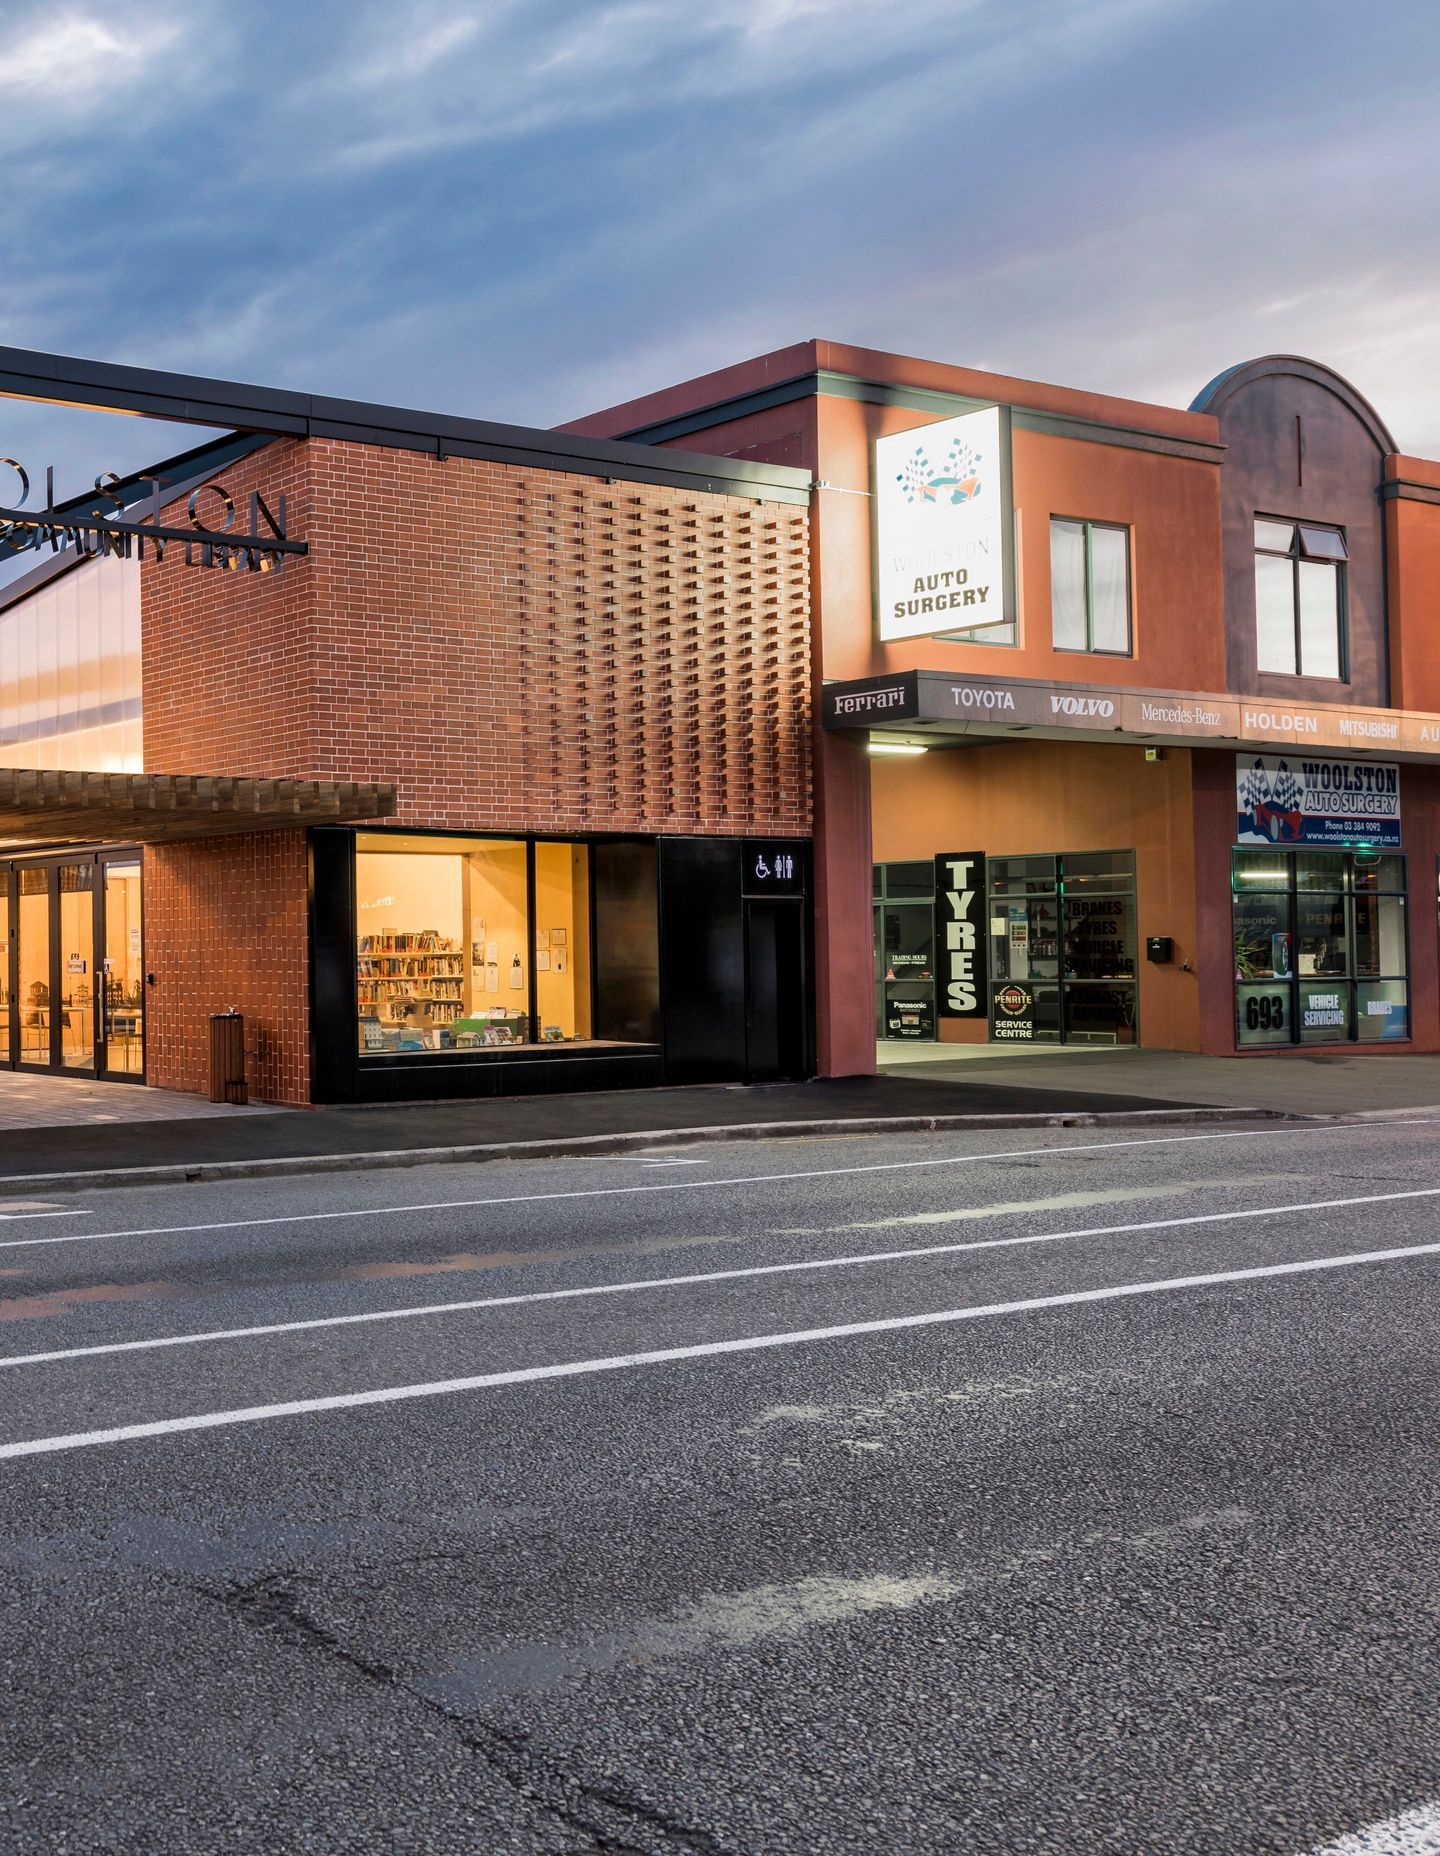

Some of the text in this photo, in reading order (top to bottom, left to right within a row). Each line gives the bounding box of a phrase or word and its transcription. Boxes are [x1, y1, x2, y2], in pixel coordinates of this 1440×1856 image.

[892, 537, 989, 573] WOOLSTON
[913, 568, 968, 594] AUTO
[894, 585, 990, 619] SURGERY
[834, 686, 905, 715] Ferrari
[951, 687, 1015, 710] TOYOTA
[1049, 695, 1114, 718] VOLVO
[1141, 702, 1221, 727] Mercedes-Benz
[1244, 711, 1318, 733] HOLDEN
[1339, 719, 1398, 740] MITSUBISHI
[1302, 762, 1397, 794] WOOLSTON
[1304, 790, 1398, 815] AUTO SURGERY
[1306, 831, 1400, 843] www.woolstonautosurgery.co.nz
[1324, 821, 1381, 832] Phone 03 384 9092
[1072, 900, 1123, 917] BRAKES
[1304, 912, 1367, 925] PENRE
[945, 860, 978, 1011] TYRES
[893, 1001, 927, 1009] Panasonic
[994, 995, 1032, 1004] PENRITE
[1308, 994, 1339, 1010] VEHICLE
[1367, 1000, 1393, 1016] BRAKES
[1246, 995, 1284, 1031] 693
[1304, 1010, 1345, 1026] SERVICING
[995, 1020, 1032, 1028] SERVICE
[995, 1029, 1032, 1038] CENTRE
